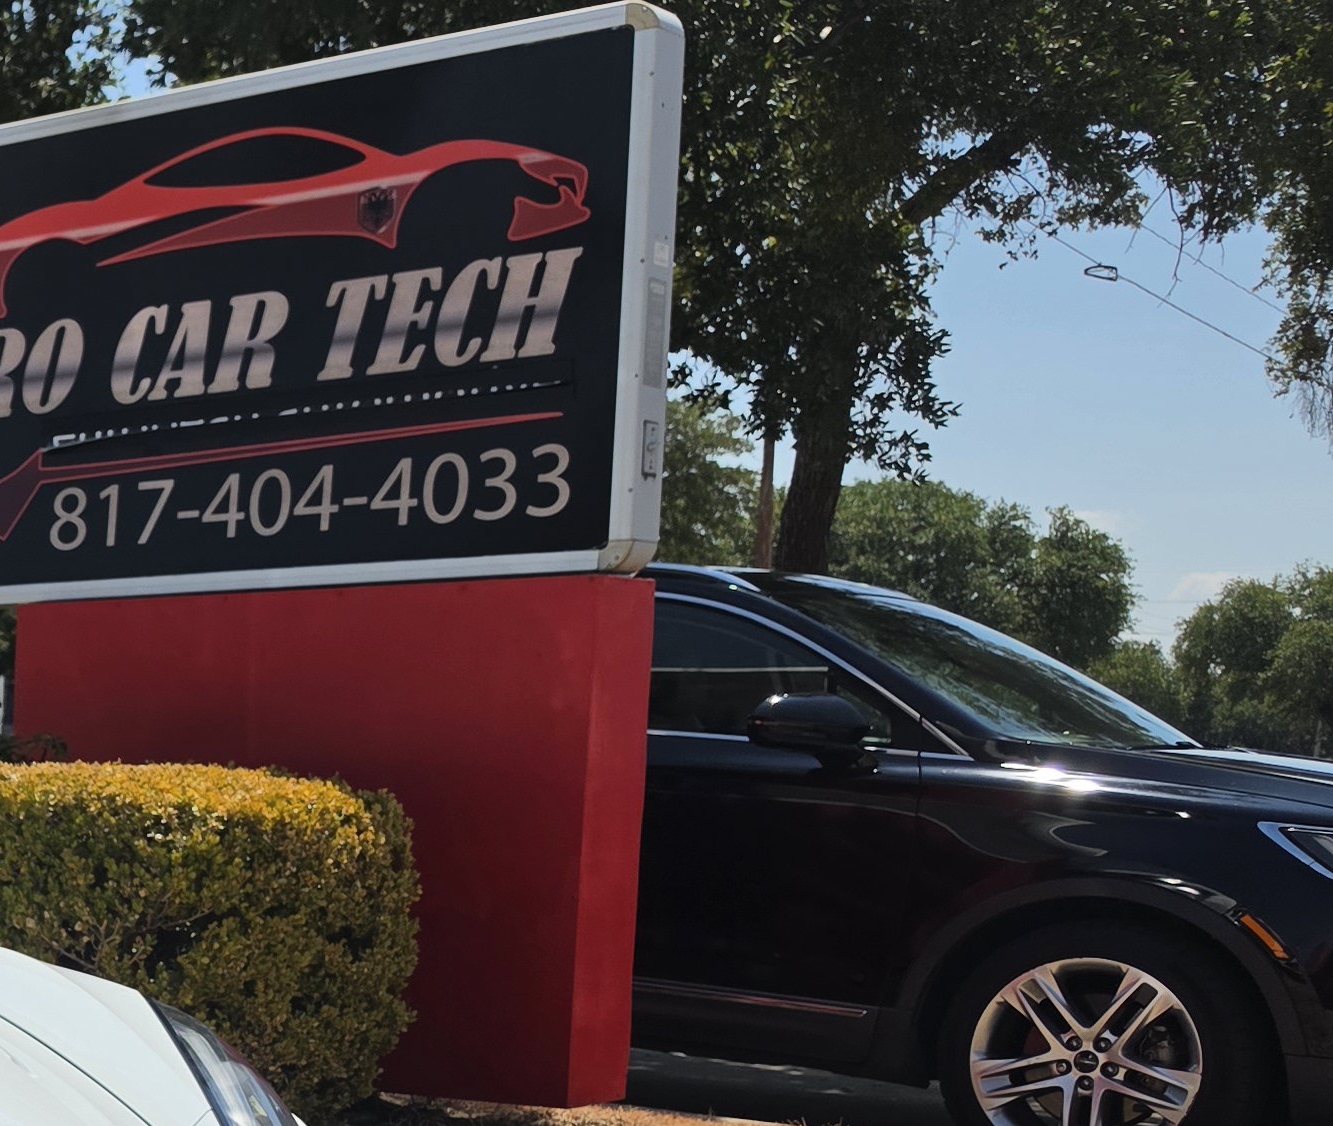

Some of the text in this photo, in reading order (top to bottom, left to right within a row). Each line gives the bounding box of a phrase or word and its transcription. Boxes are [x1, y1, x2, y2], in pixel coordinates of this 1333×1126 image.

[110, 289, 289, 405] CAR
[316, 246, 583, 383] TECH
[48, 442, 571, 552] 817-404-4033
